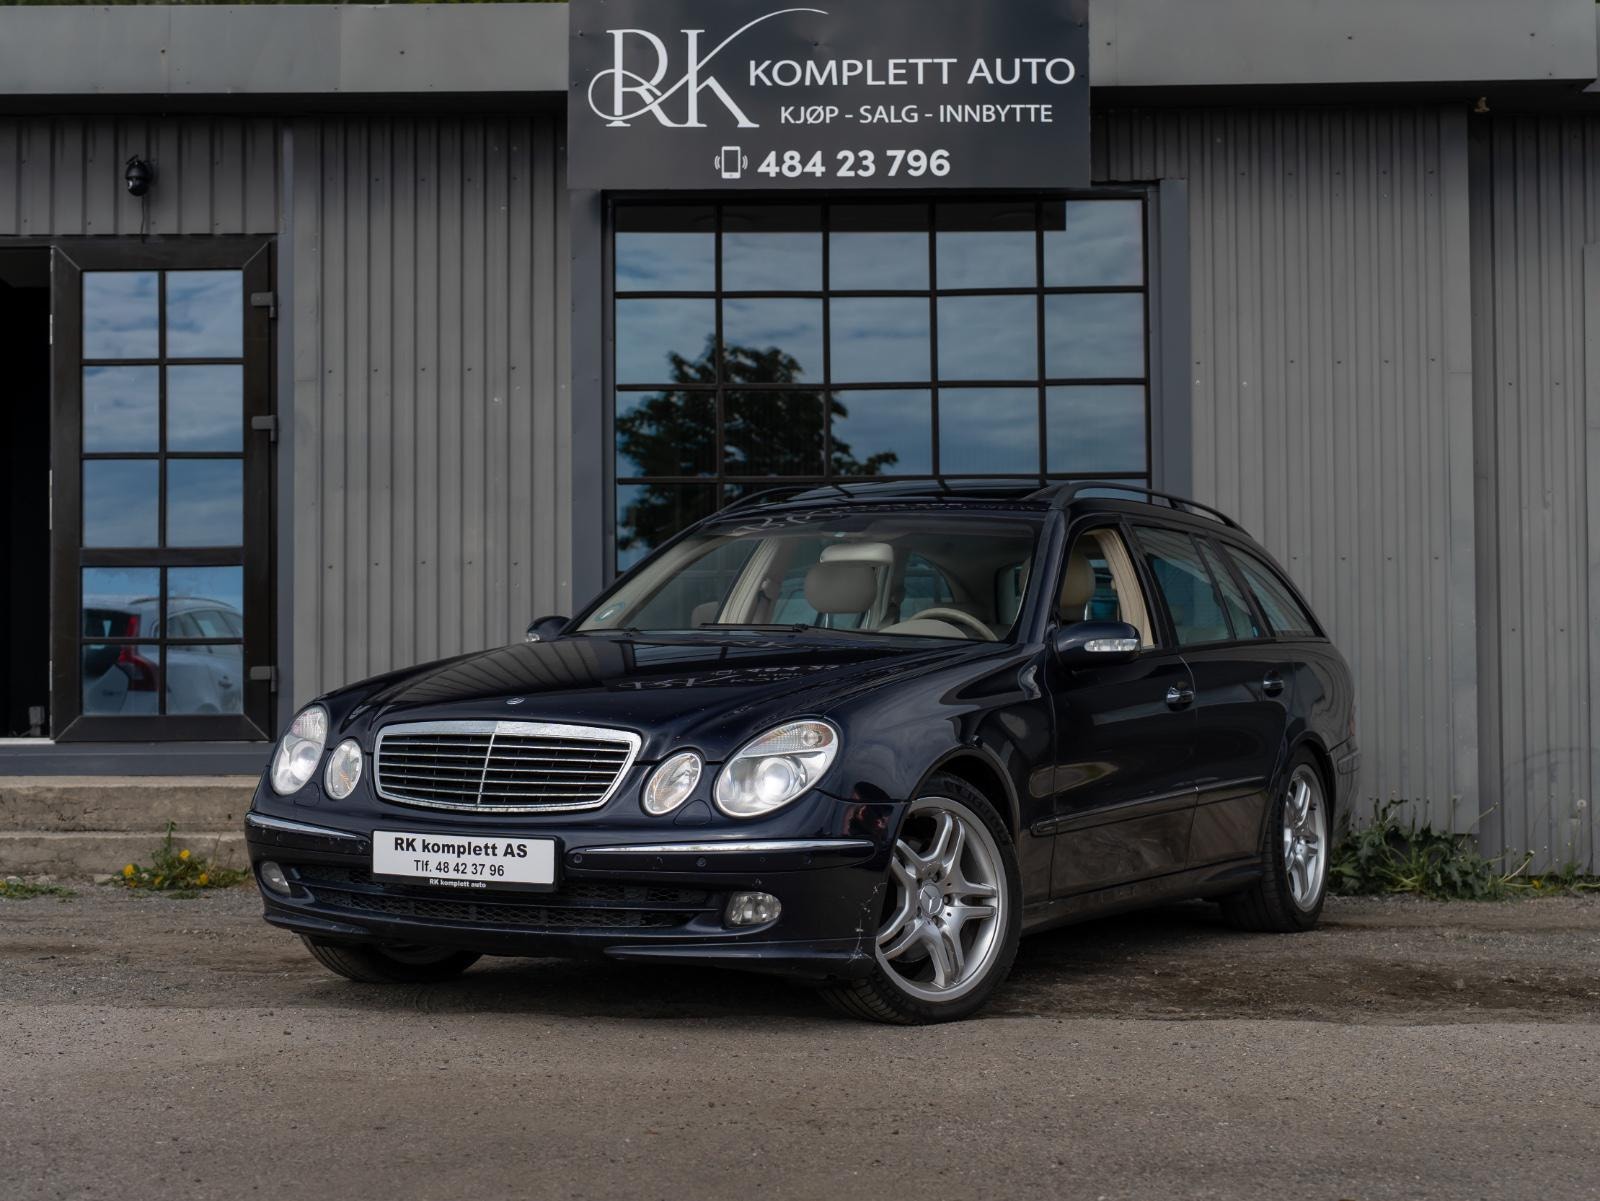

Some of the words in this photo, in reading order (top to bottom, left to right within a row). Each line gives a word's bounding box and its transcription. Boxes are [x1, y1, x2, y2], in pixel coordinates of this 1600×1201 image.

[749, 58, 958, 87] KOMPLETT
[967, 57, 1075, 85] AUTO
[780, 104, 839, 125] KJØP
[859, 104, 919, 124] SALG
[939, 104, 1053, 123] INNBYTTE
[757, 149, 826, 179] 484
[836, 149, 876, 178] 23
[886, 148, 951, 178] 796
[394, 836, 417, 852] RK
[421, 838, 498, 859] komplett
[502, 843, 528, 859] AS
[413, 859, 432, 873] Tlf.
[435, 861, 450, 874] 48
[452, 862, 468, 875] 42
[471, 863, 486, 876] 37
[489, 864, 505, 877] 96
[429, 878, 439, 886] RK
[440, 879, 470, 889] komplett
